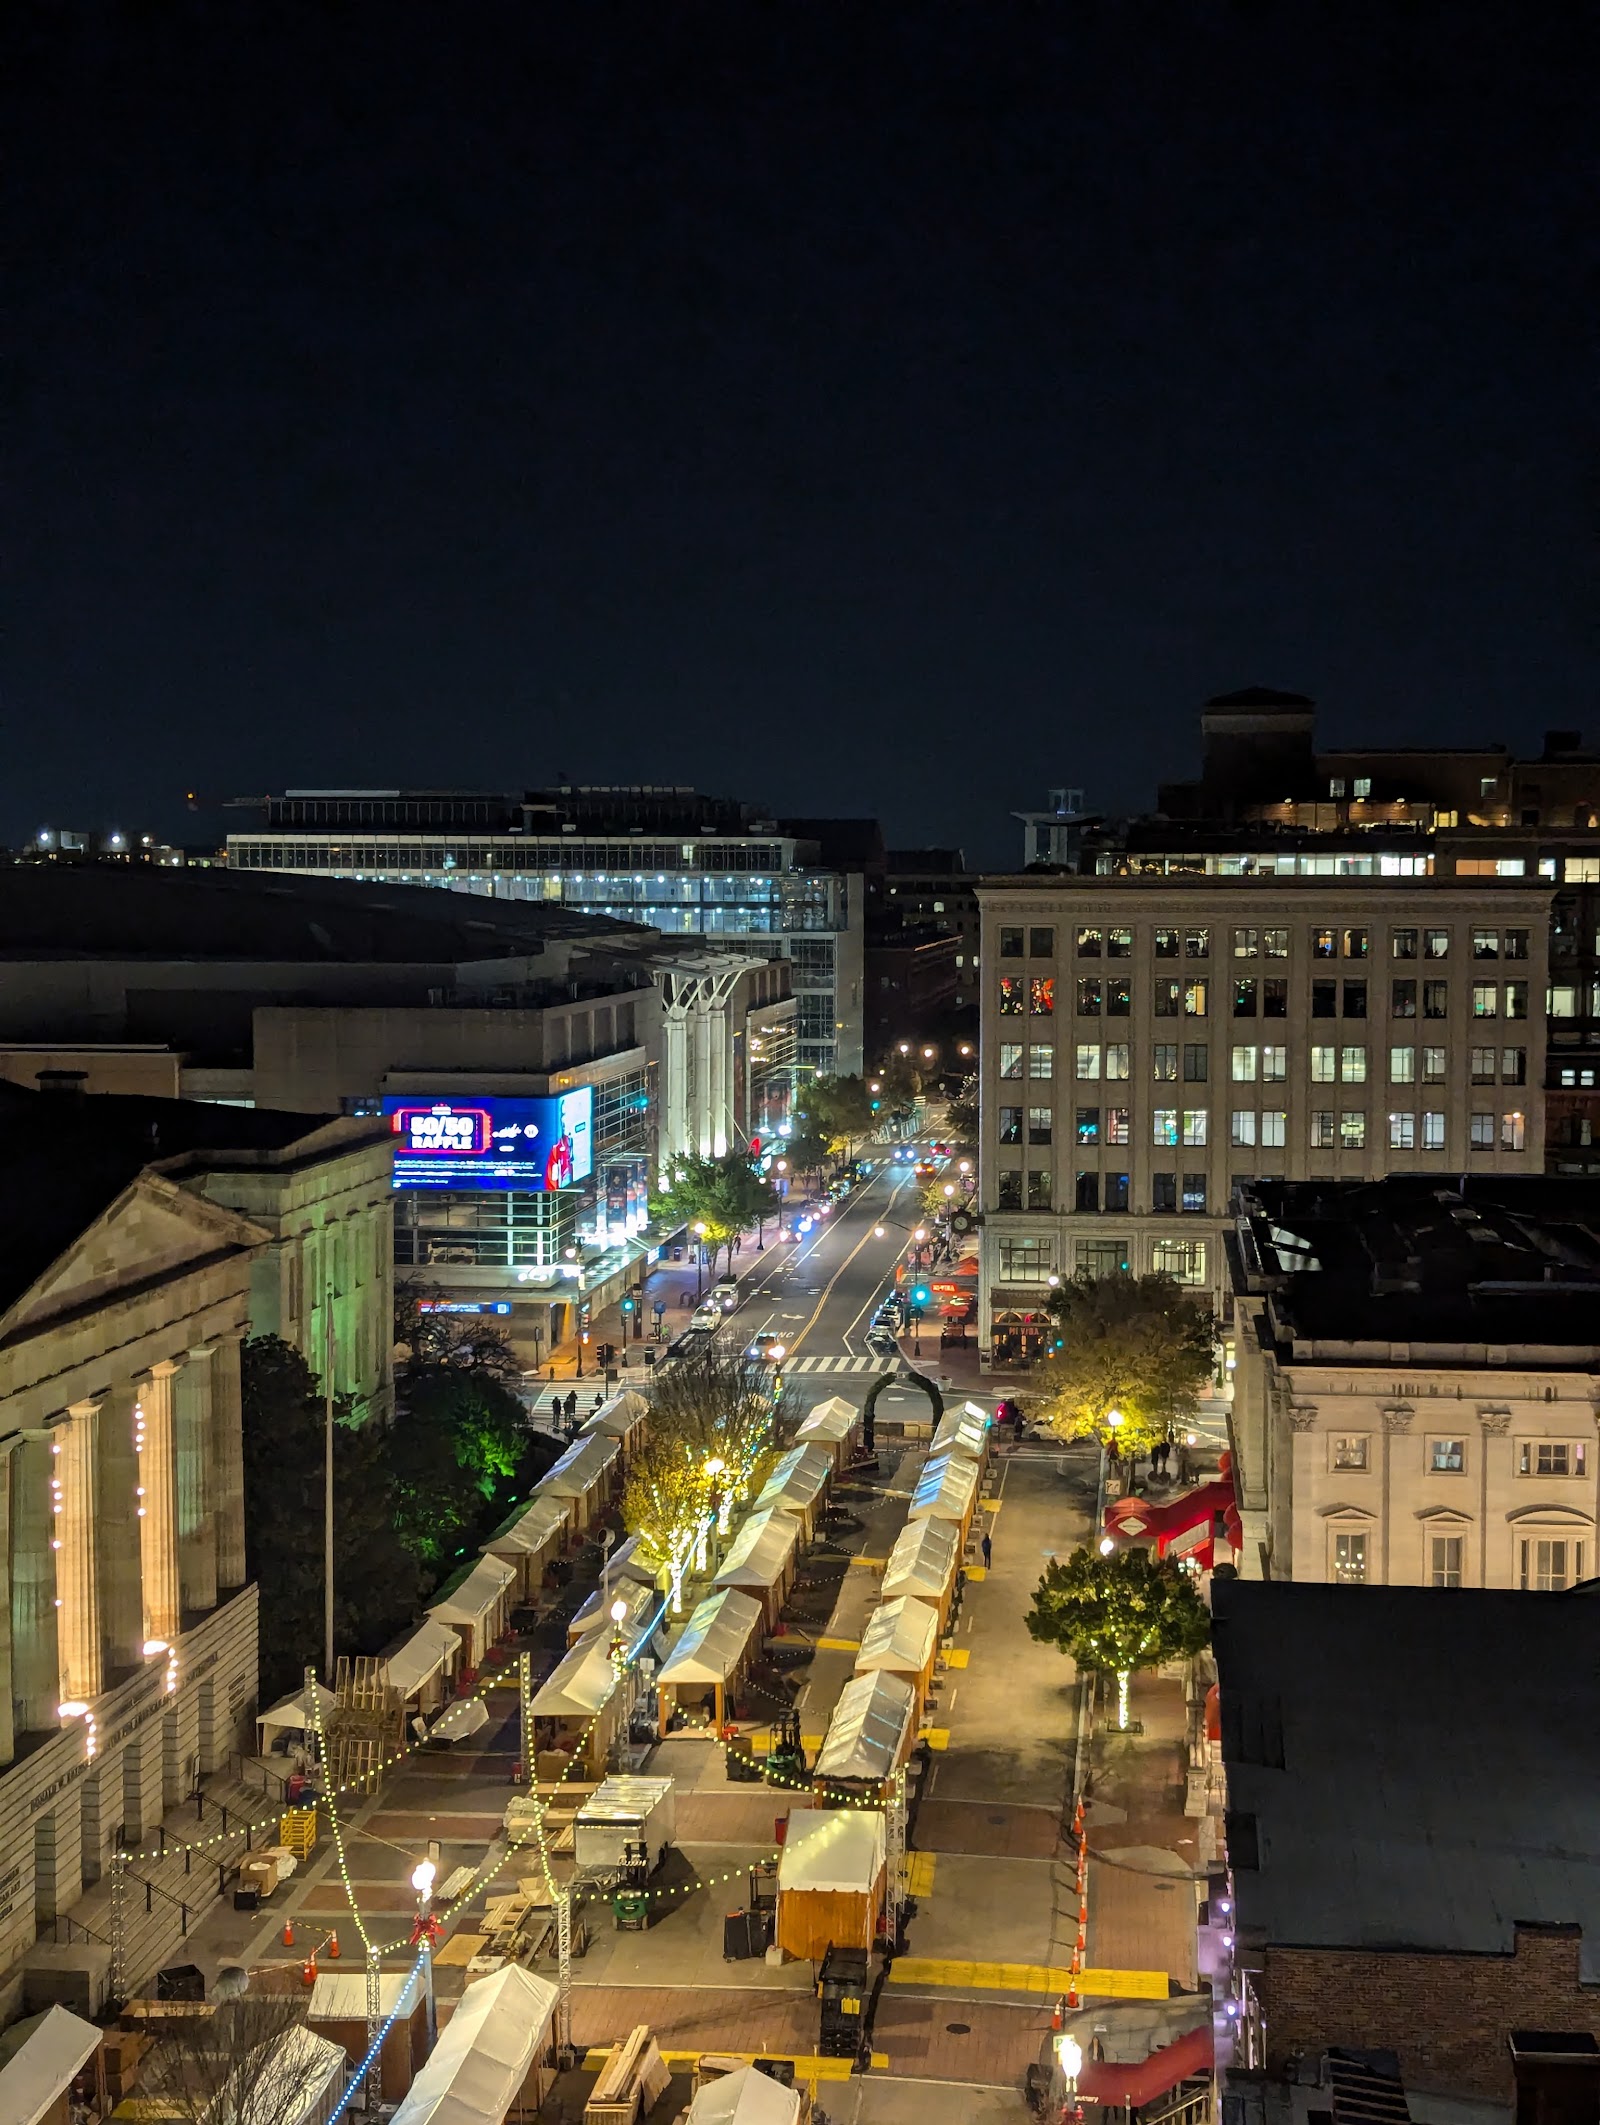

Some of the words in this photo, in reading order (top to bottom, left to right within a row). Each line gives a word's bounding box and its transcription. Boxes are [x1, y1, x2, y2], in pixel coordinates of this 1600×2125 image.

[411, 1116, 473, 1136] 50/50
[412, 1136, 472, 1149] RAFFLE
[1009, 1327, 1018, 1335] MI
[1021, 1327, 1039, 1336] VIDA
